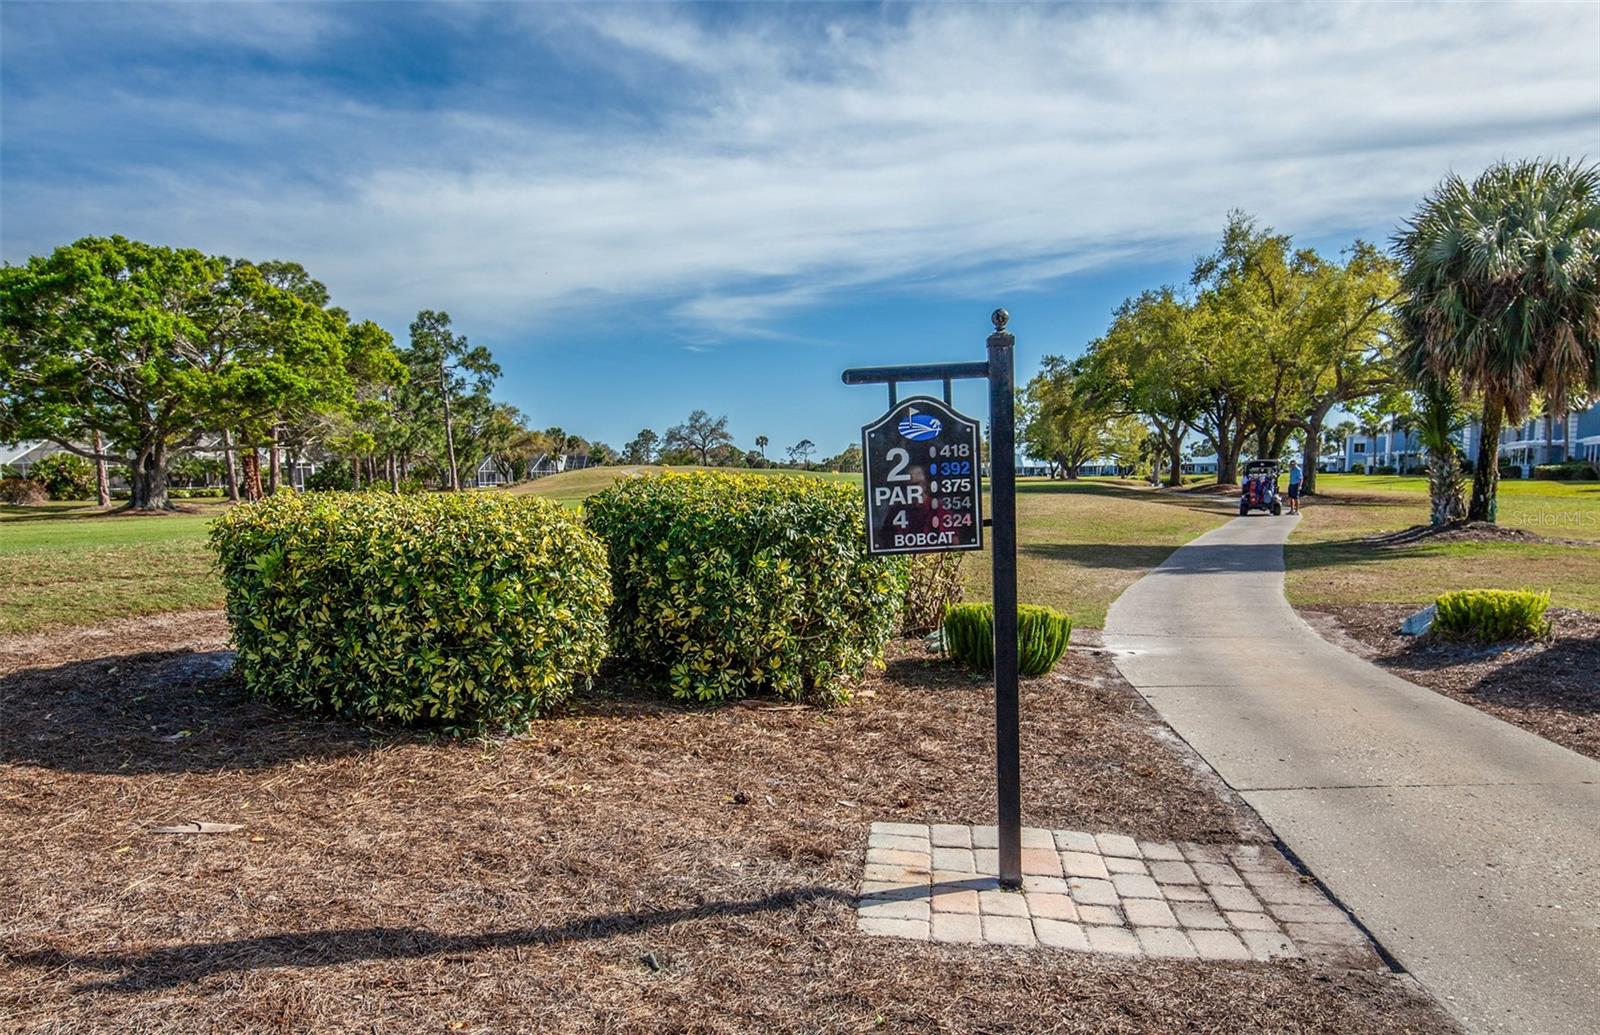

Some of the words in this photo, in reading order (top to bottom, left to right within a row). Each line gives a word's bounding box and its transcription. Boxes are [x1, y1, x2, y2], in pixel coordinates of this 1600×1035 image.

[939, 443, 970, 458] 418
[885, 447, 912, 482] 2
[941, 461, 970, 476] 392
[941, 478, 971, 493] 375
[875, 485, 924, 506] PAR
[942, 496, 972, 510] 354
[892, 510, 909, 529] 4
[943, 513, 973, 528] 324
[894, 531, 955, 547] BOBCAT
